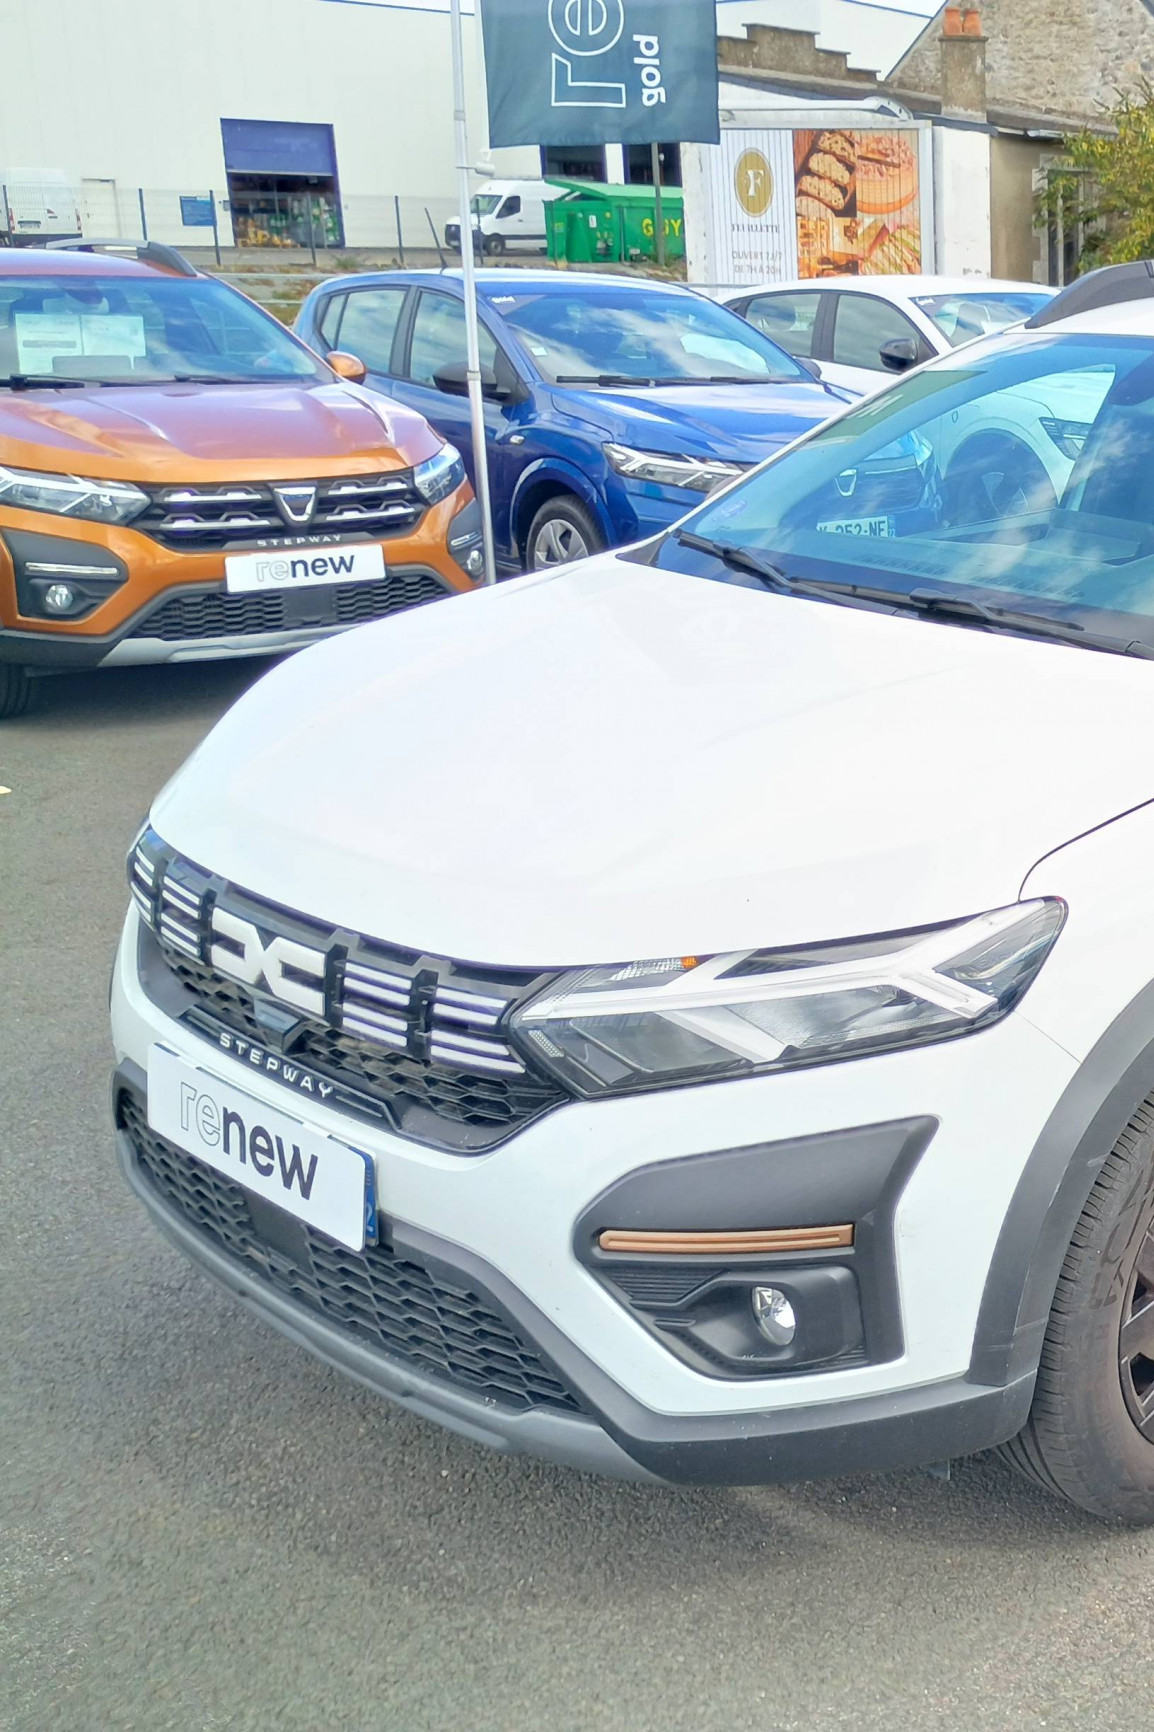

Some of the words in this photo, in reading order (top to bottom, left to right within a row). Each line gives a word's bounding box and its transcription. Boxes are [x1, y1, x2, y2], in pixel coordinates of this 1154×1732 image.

[632, 33, 667, 108] gold
[731, 250, 763, 261] OUVERT
[256, 534, 343, 547] STEPWAY
[255, 554, 355, 583] renew
[219, 1032, 334, 1099] STEPWAY
[179, 1081, 319, 1201] renew
